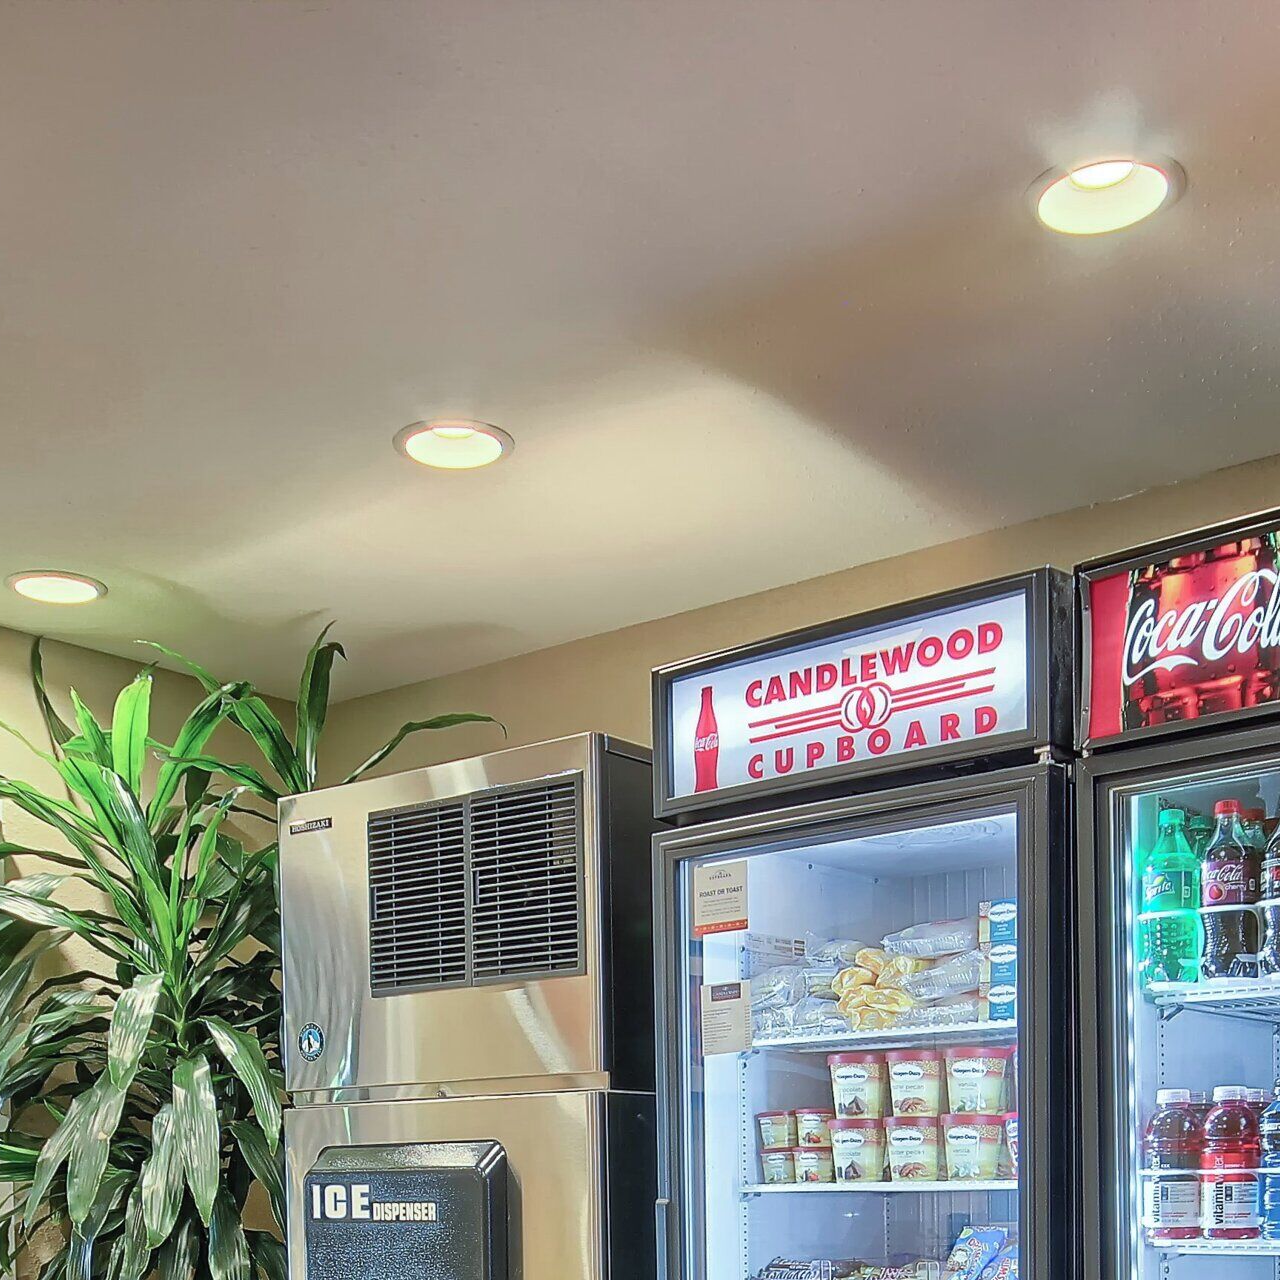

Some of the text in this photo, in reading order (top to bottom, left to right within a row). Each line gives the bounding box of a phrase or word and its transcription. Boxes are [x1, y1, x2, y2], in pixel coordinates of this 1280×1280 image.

[745, 621, 1003, 707] CANDLEWOOD
[748, 705, 998, 779] CUPBOARD
[312, 1184, 437, 1221] ICE DISPENSER
